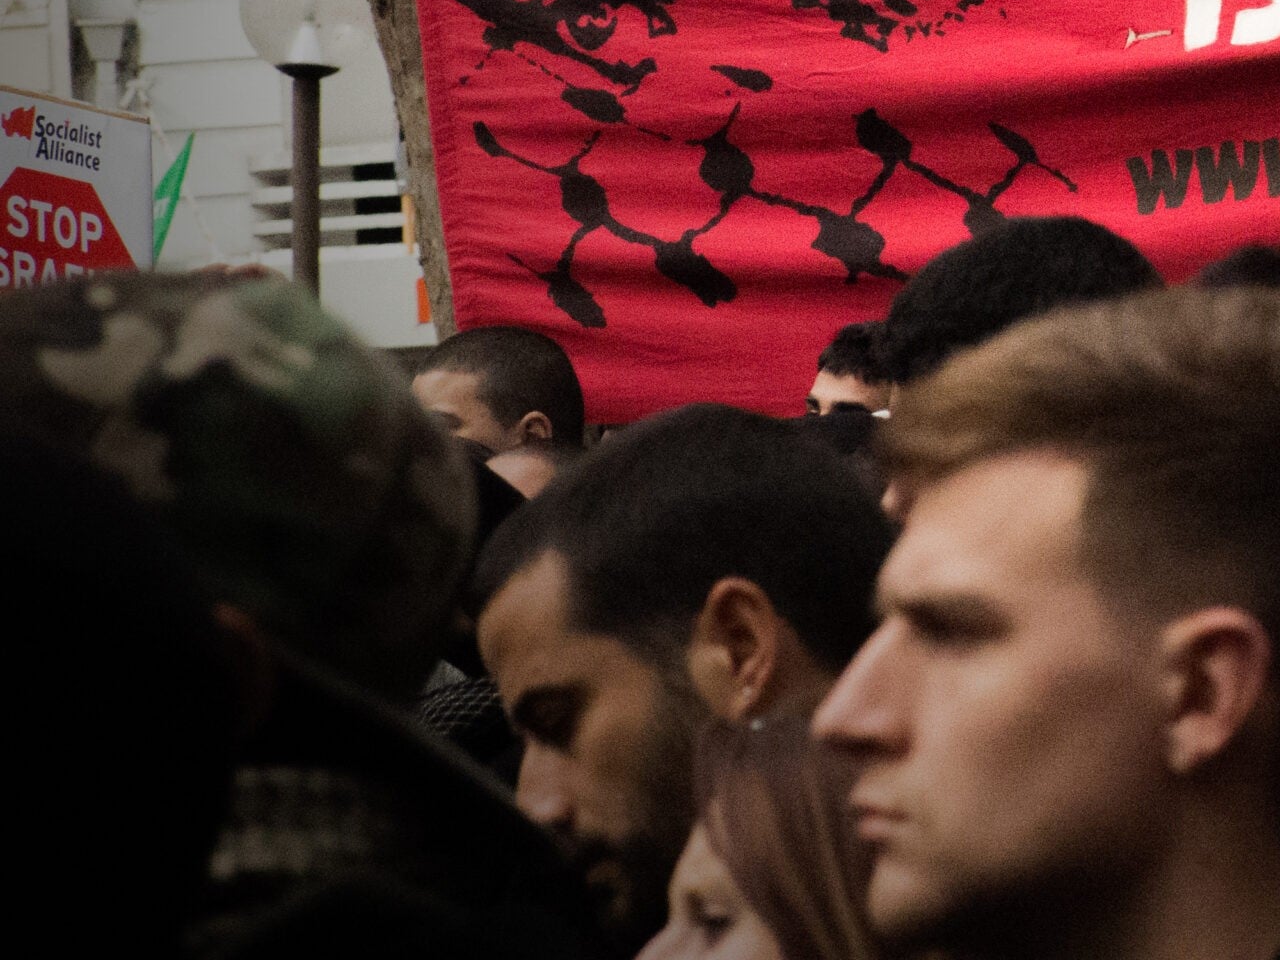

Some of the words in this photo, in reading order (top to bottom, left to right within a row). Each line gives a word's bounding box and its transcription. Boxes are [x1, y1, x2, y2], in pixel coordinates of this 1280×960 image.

[35, 115, 102, 149] Socialist
[36, 137, 100, 171] Alliance
[7, 195, 103, 253] STOP
